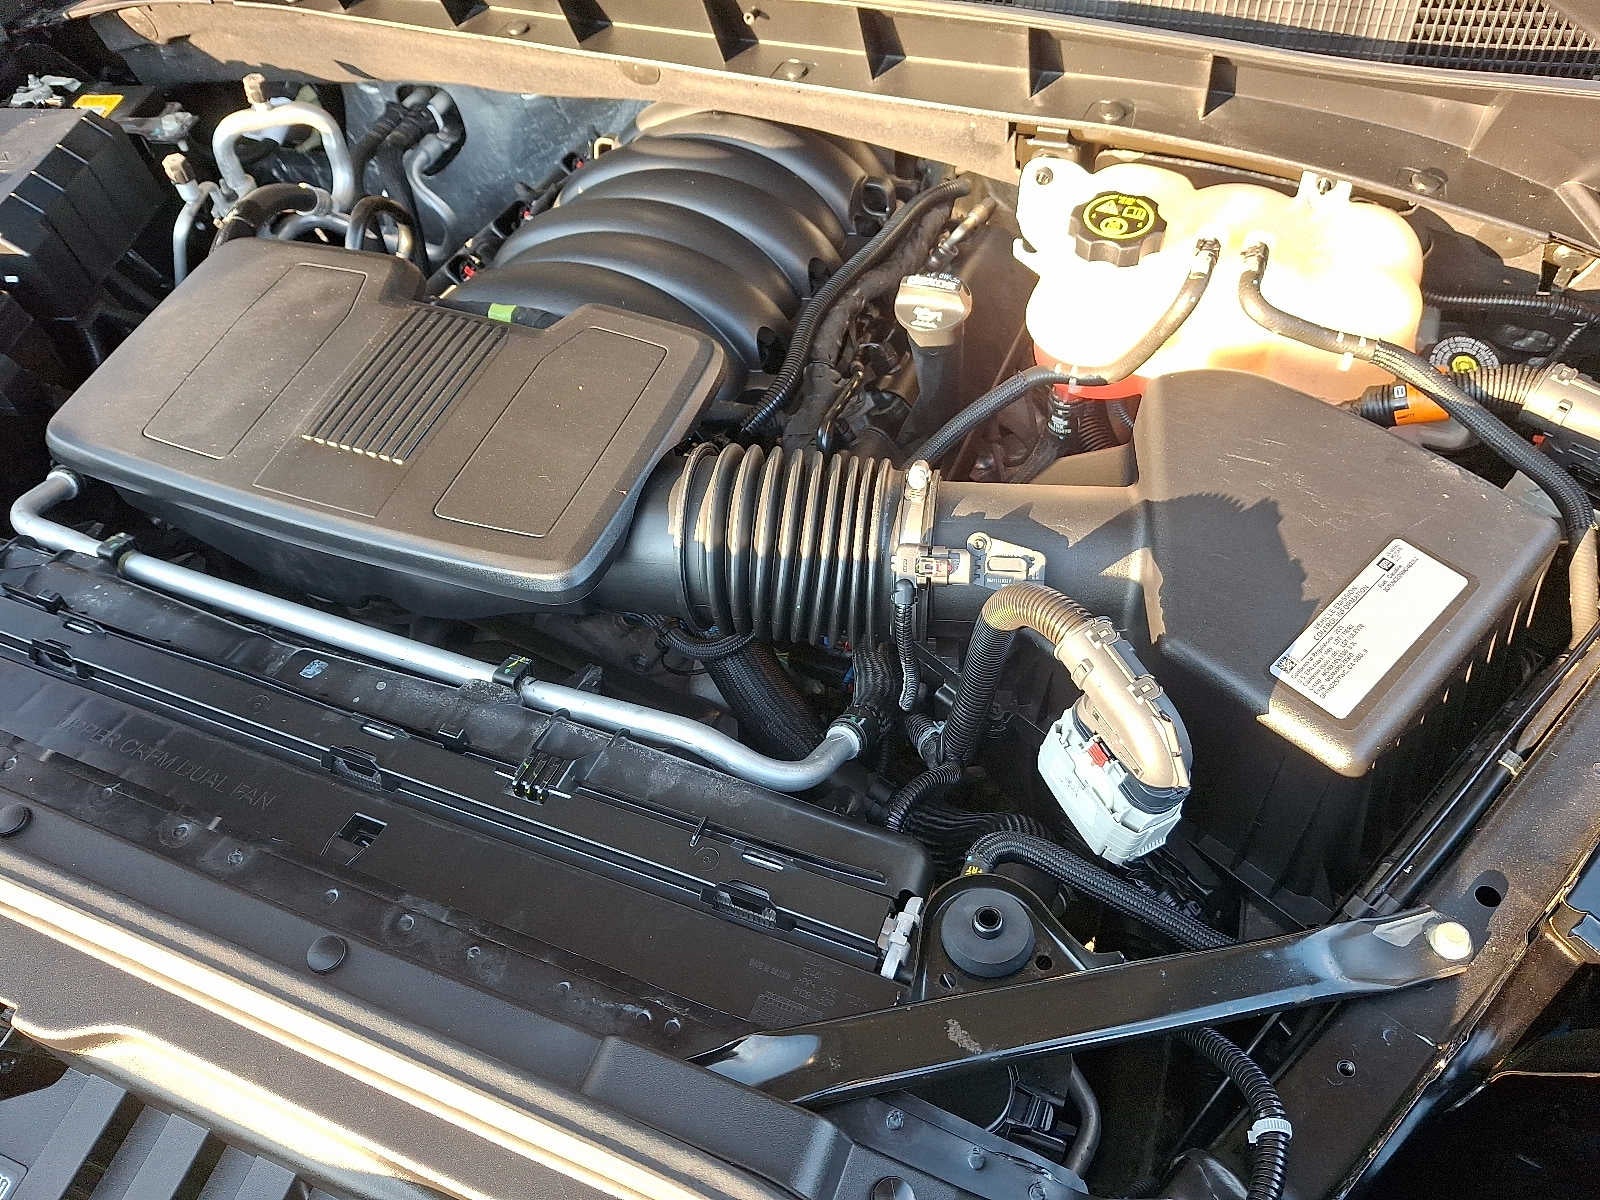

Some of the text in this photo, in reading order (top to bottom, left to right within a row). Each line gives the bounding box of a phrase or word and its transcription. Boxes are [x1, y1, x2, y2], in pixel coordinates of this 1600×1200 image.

[1312, 615, 1338, 641] CONTROL
[1334, 583, 1369, 617] INFORMATION
[1313, 607, 1336, 630] VEHICLE
[1333, 585, 1358, 609] EMISSION
[175, 756, 229, 793] DUAL
[231, 782, 279, 810] FAN
